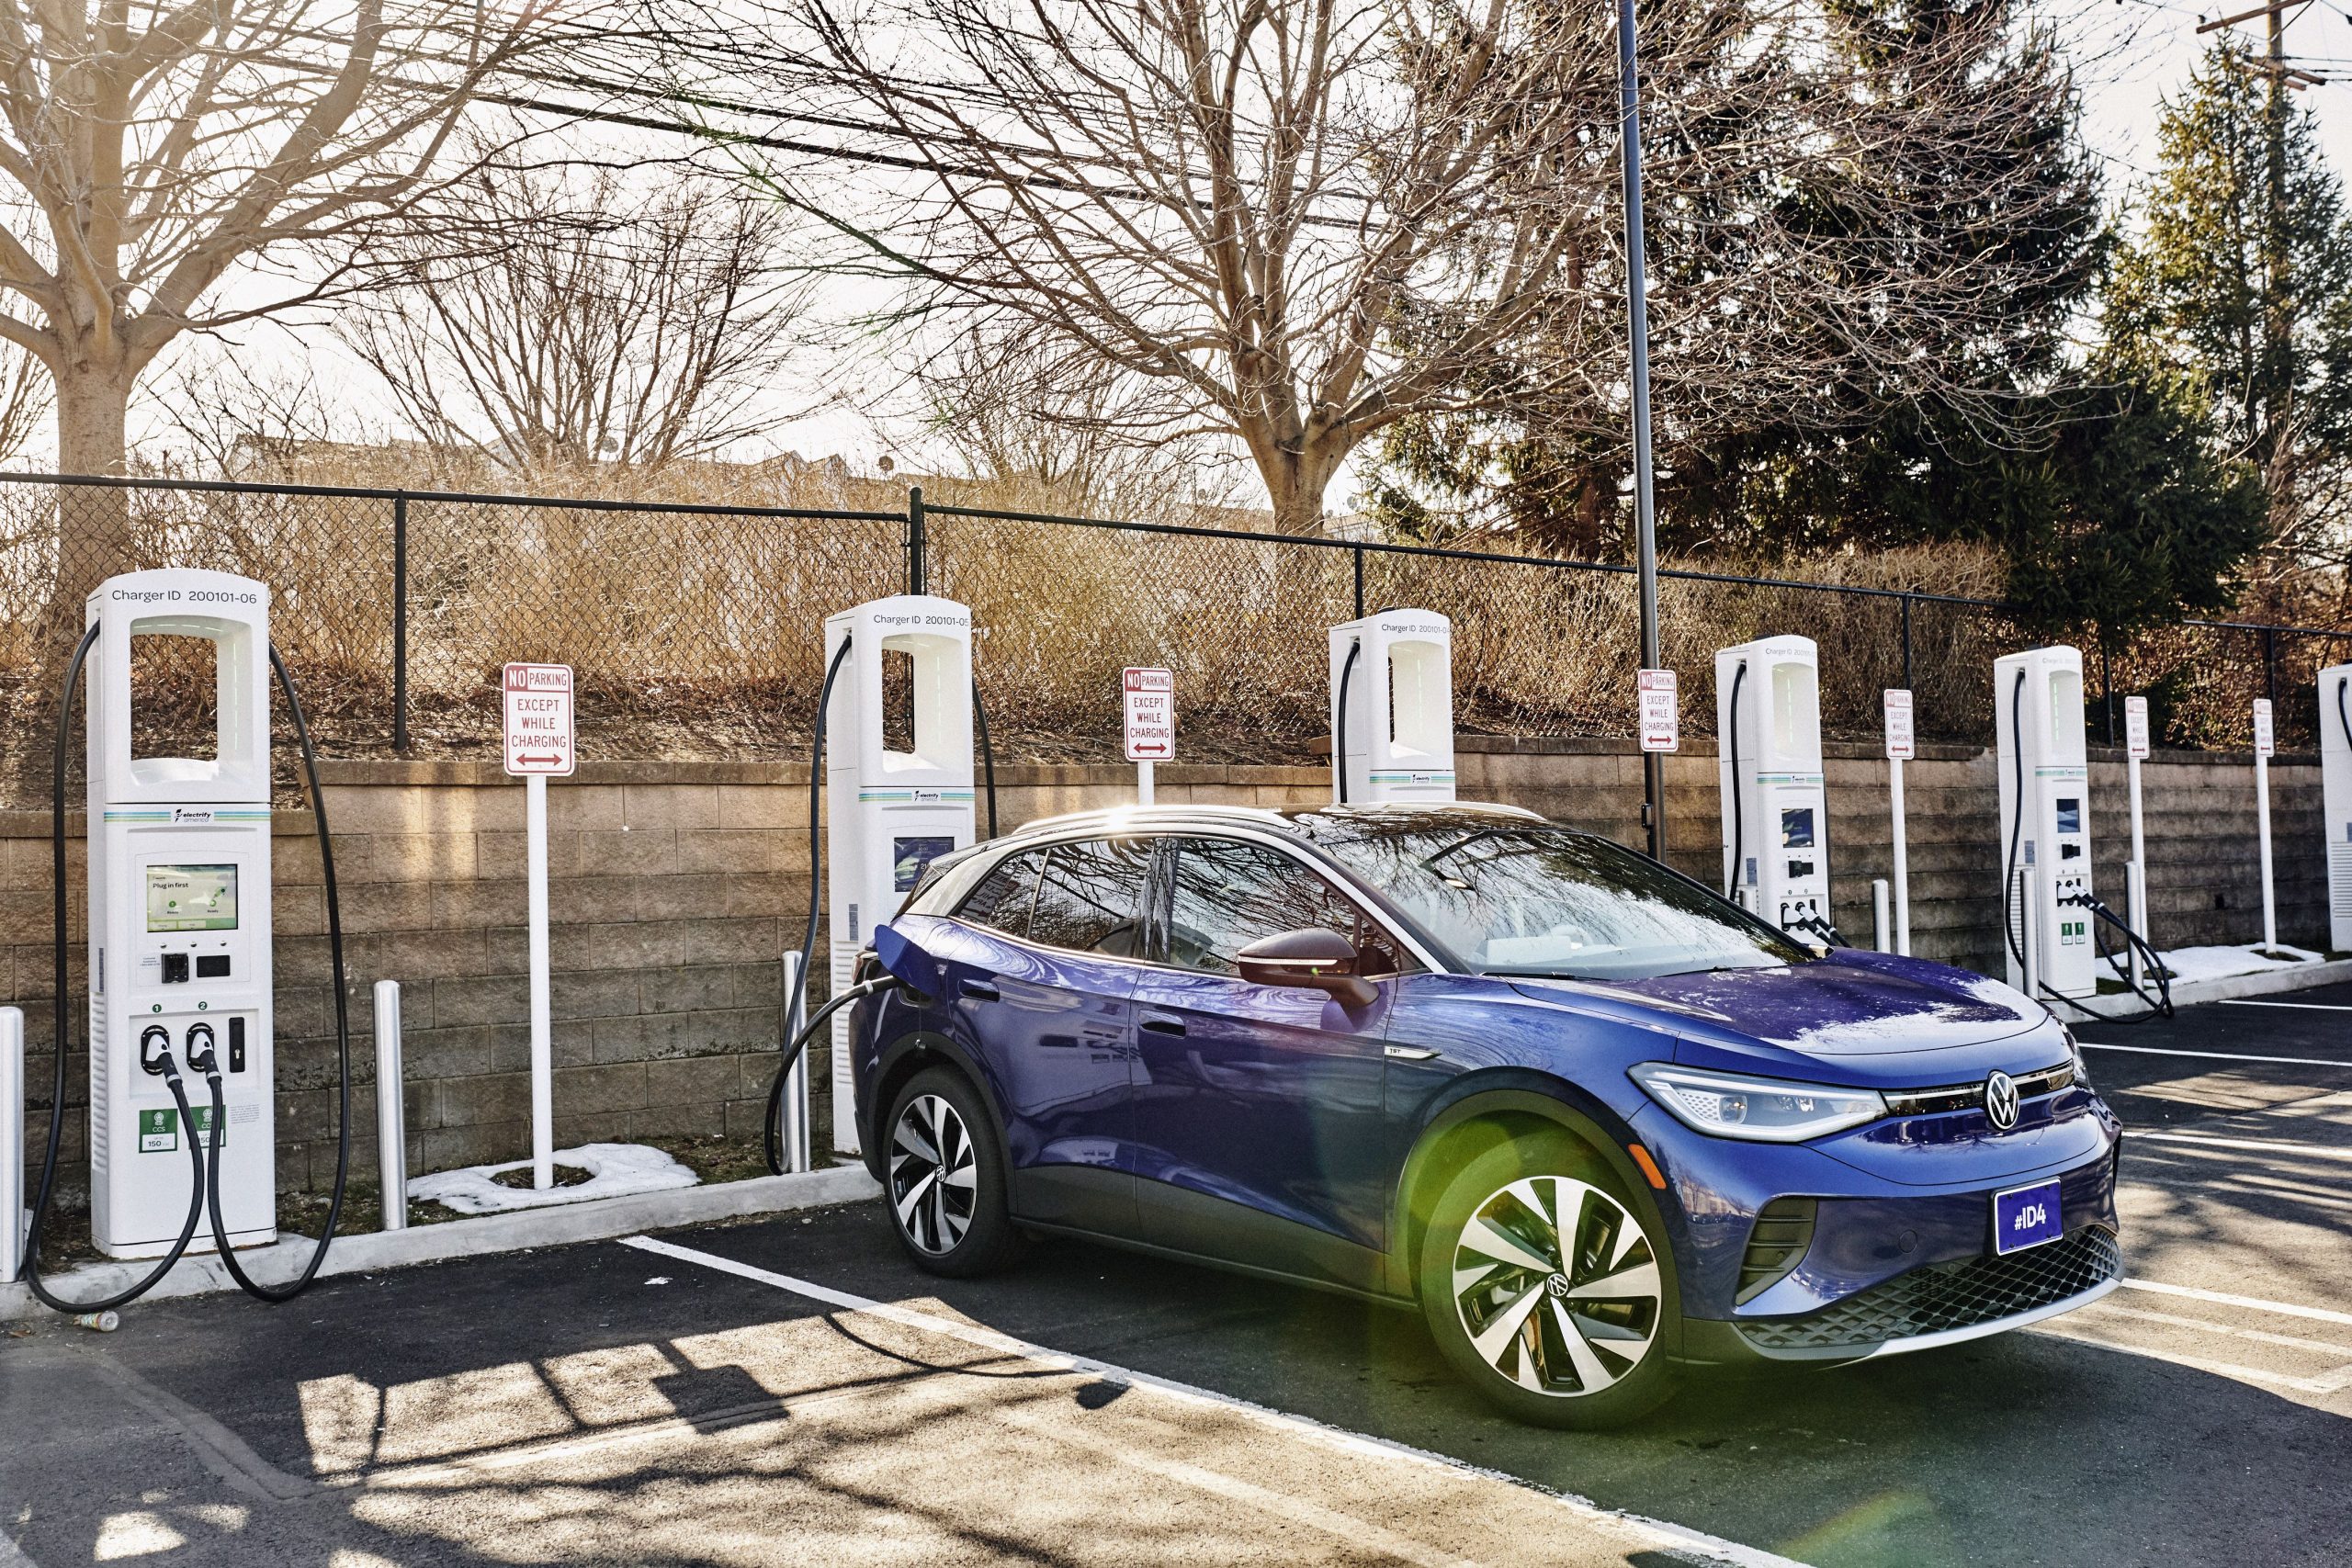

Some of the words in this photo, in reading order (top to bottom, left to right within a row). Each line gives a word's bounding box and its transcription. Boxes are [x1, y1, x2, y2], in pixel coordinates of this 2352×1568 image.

[112, 590, 165, 603] Charger
[168, 590, 181, 601] ID
[188, 591, 257, 604] 200101-06
[874, 615, 909, 626] Charger
[911, 615, 921, 624] ID
[925, 616, 969, 626] 200101-05
[1381, 624, 1408, 632] Charger
[509, 670, 526, 687] NO
[529, 672, 567, 686] PARKING
[1127, 673, 1139, 688] NO
[1142, 676, 1169, 687] PARKING
[1641, 674, 1651, 687] NO
[1652, 676, 1674, 686] PARKING
[517, 699, 559, 711] EXCEPT
[1134, 698, 1164, 708] EXCEPT
[1647, 695, 1669, 705] EXCEPT
[1137, 712, 1161, 723] WHILE
[1649, 709, 1668, 718] WHILE
[521, 717, 556, 729] WHILE
[1644, 722, 1674, 731] CHARGING
[1130, 728, 1169, 738] CHARGING
[511, 735, 566, 747] CHARGING
[2014, 1203, 2046, 1230] #ID4
